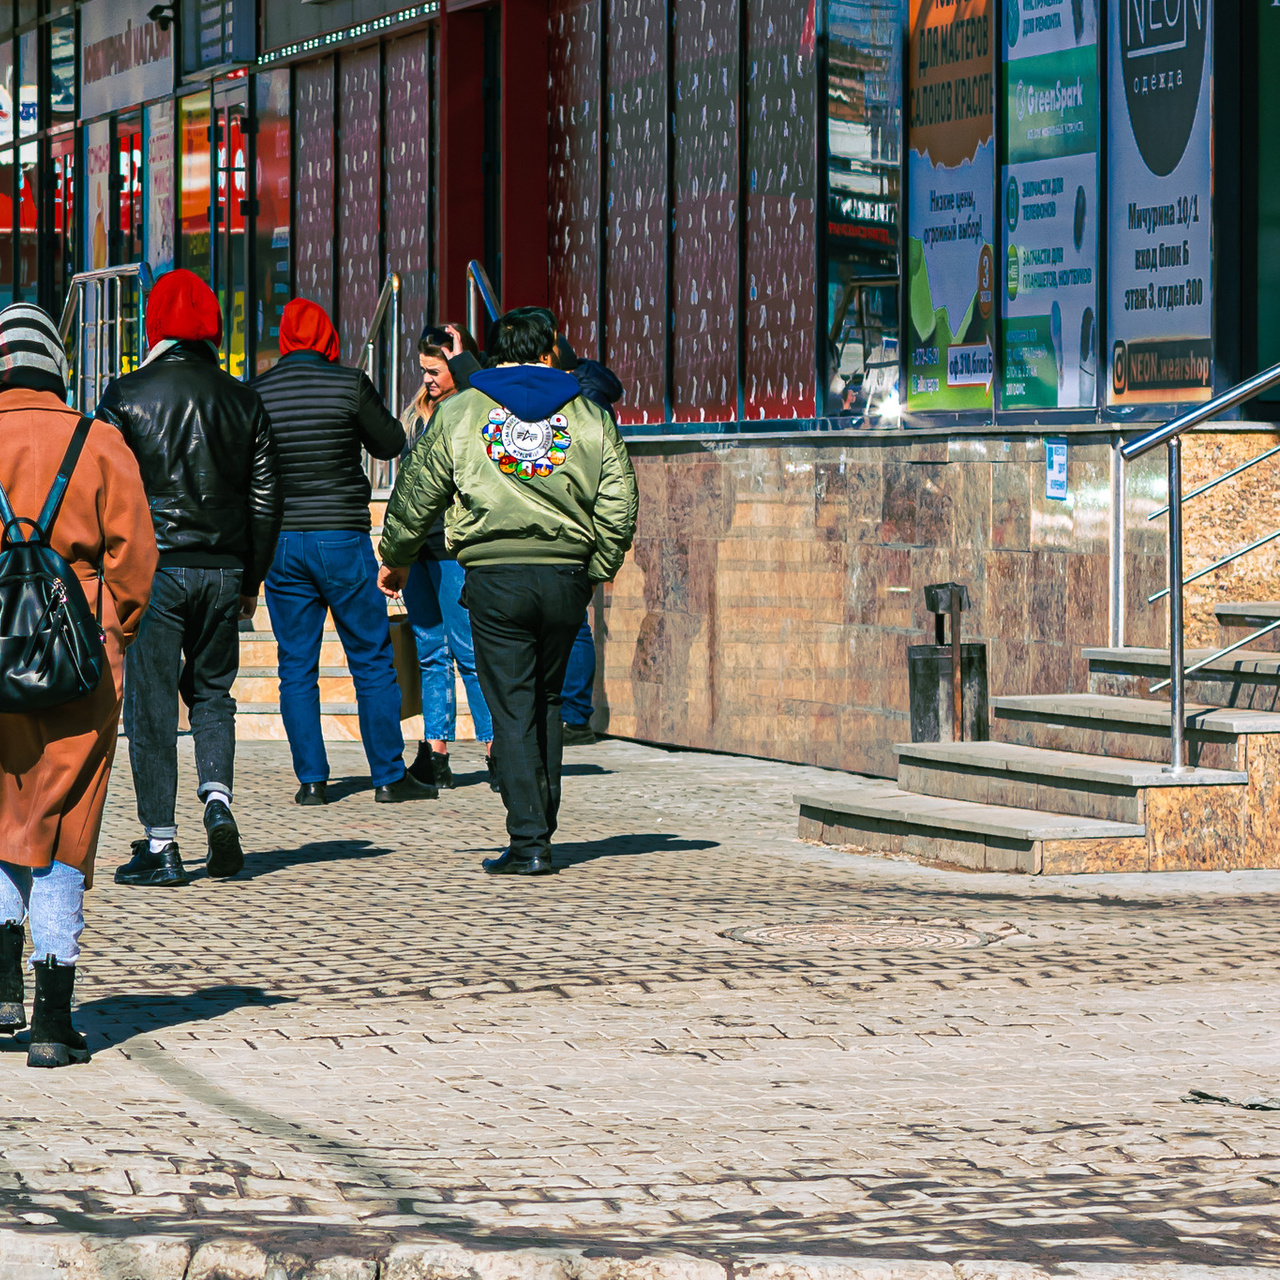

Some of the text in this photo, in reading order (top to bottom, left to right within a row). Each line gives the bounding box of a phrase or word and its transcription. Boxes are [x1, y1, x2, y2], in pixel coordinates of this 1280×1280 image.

[919, 14, 990, 78] ДЛЯ МАСТЕРОВ
[1027, 76, 1084, 117] GreenSpark
[1133, 69, 1183, 95] одежда
[930, 189, 954, 212] Низкие
[1128, 194, 1199, 234] Мичурина 10/1
[924, 215, 957, 249] огромный
[982, 255, 990, 288] 3
[1135, 240, 1189, 272] вход блок Б
[1125, 278, 1203, 311] этаж 3, отдел 300
[1130, 351, 1209, 385] NEON.wearshop
